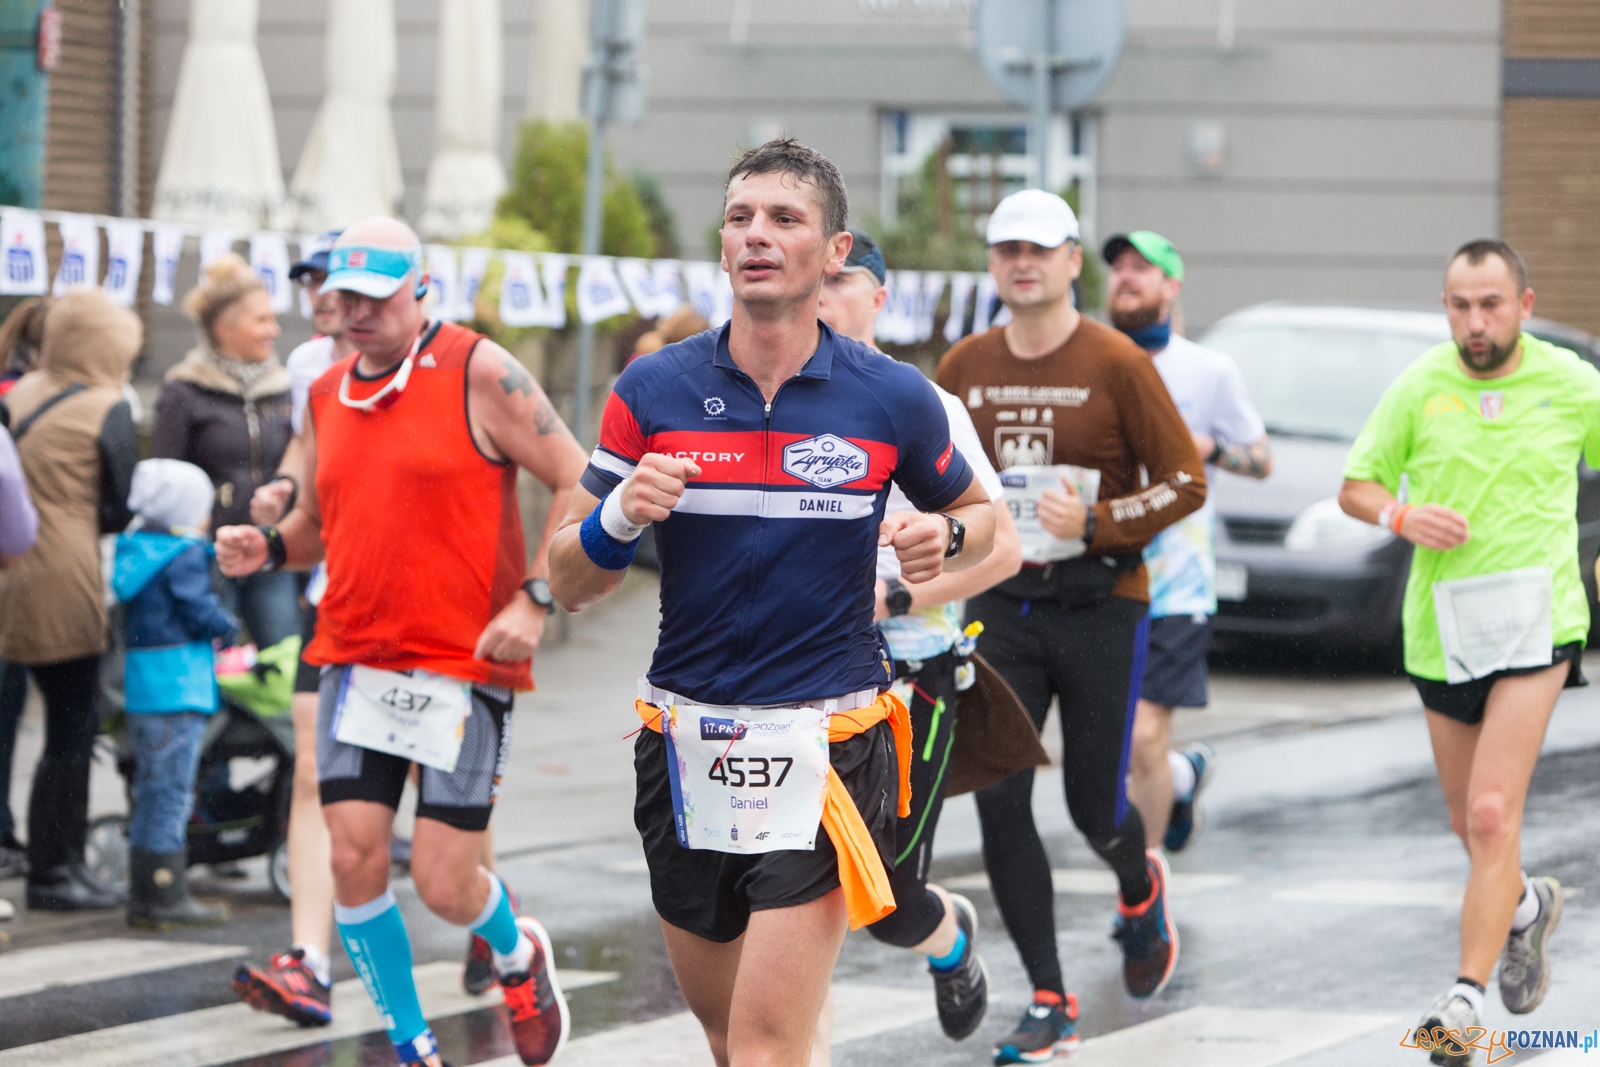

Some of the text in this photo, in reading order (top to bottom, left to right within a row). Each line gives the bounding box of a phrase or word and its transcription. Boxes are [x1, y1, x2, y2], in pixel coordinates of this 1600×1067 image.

[660, 451, 746, 462] ACTORY
[799, 498, 843, 513] DANIEL
[380, 686, 433, 713] 437
[751, 729, 789, 737] maraton
[708, 756, 794, 788] 4537
[730, 796, 768, 810] Daniel
[755, 831, 770, 841] 4F
